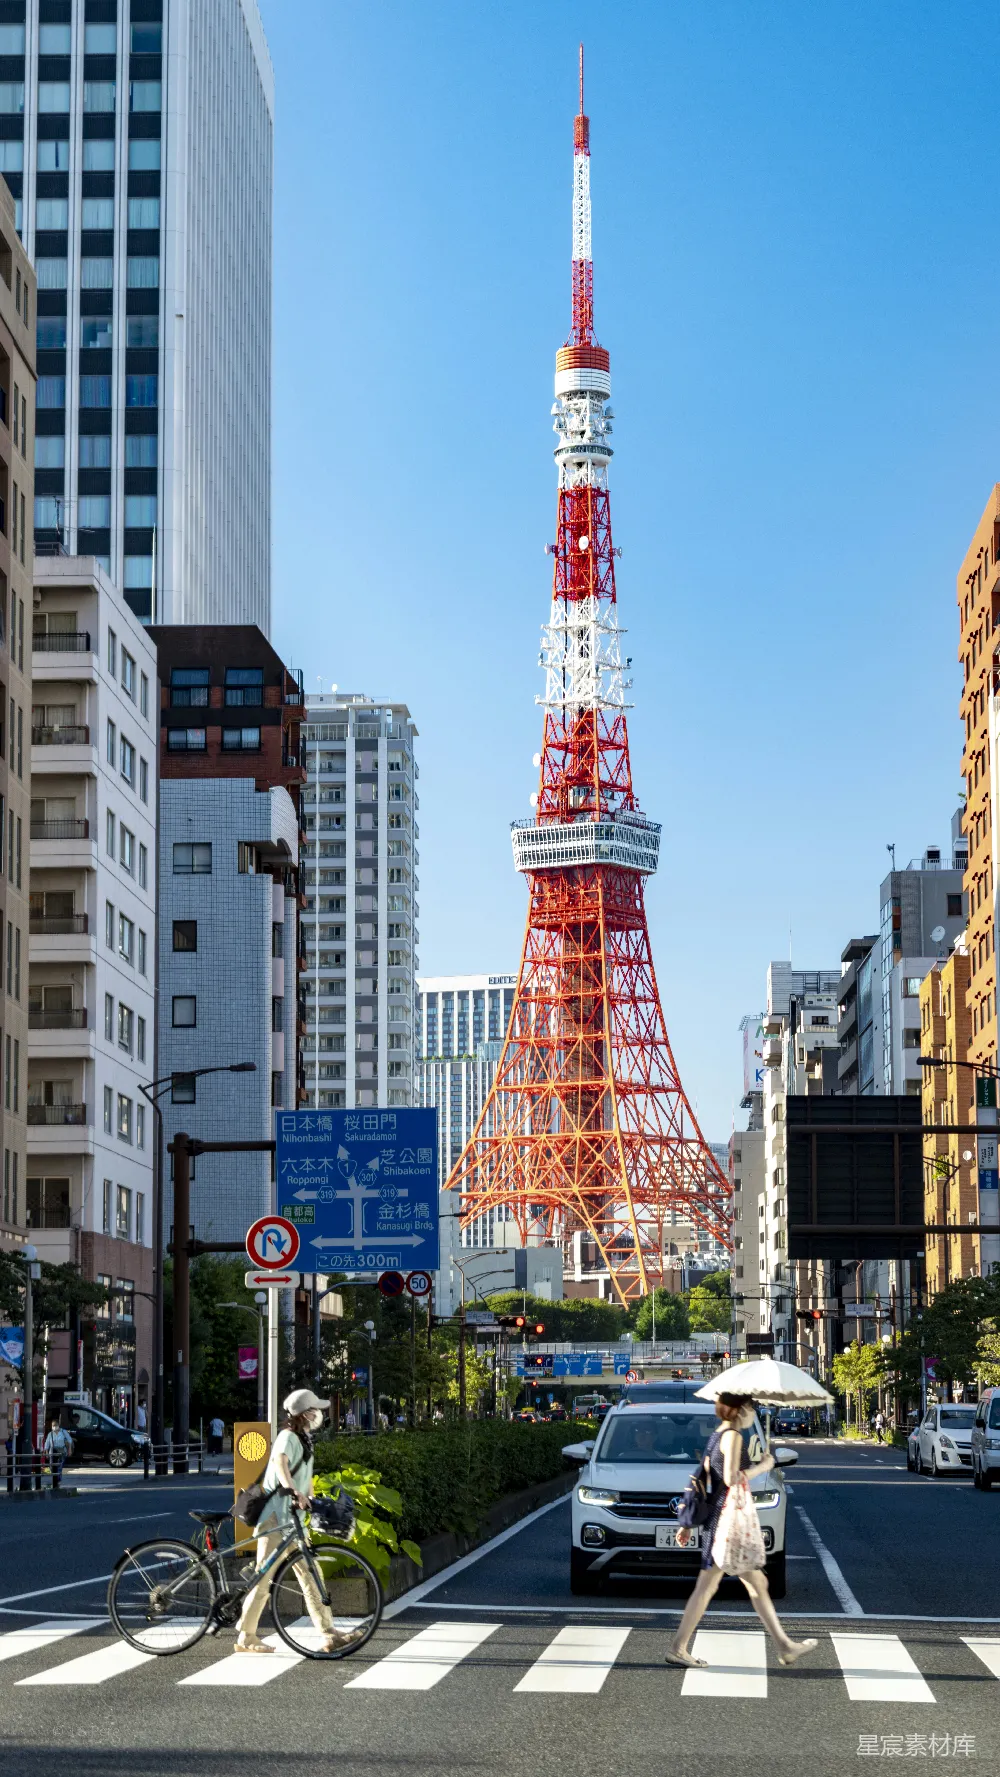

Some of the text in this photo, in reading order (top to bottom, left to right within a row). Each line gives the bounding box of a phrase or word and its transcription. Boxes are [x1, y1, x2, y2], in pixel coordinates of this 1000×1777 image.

[282, 1113, 397, 1132] 日本橋 桜田門
[282, 1132, 397, 1143] Nihonbashi Sakuradamon
[380, 1148, 433, 1165] 芝公園
[281, 1156, 334, 1174] 六本木
[343, 1162, 349, 1173] 1
[383, 1166, 431, 1176] Shibakoen
[287, 1175, 329, 1186] Roppongi
[361, 1172, 374, 1182] 301
[320, 1190, 333, 1199] 319
[382, 1188, 395, 1198] 319
[283, 1206, 314, 1217] 首都高
[379, 1203, 430, 1219] 金杉橋
[376, 1220, 435, 1232] Kanasugi Brdg.
[411, 1277, 426, 1289] 50
